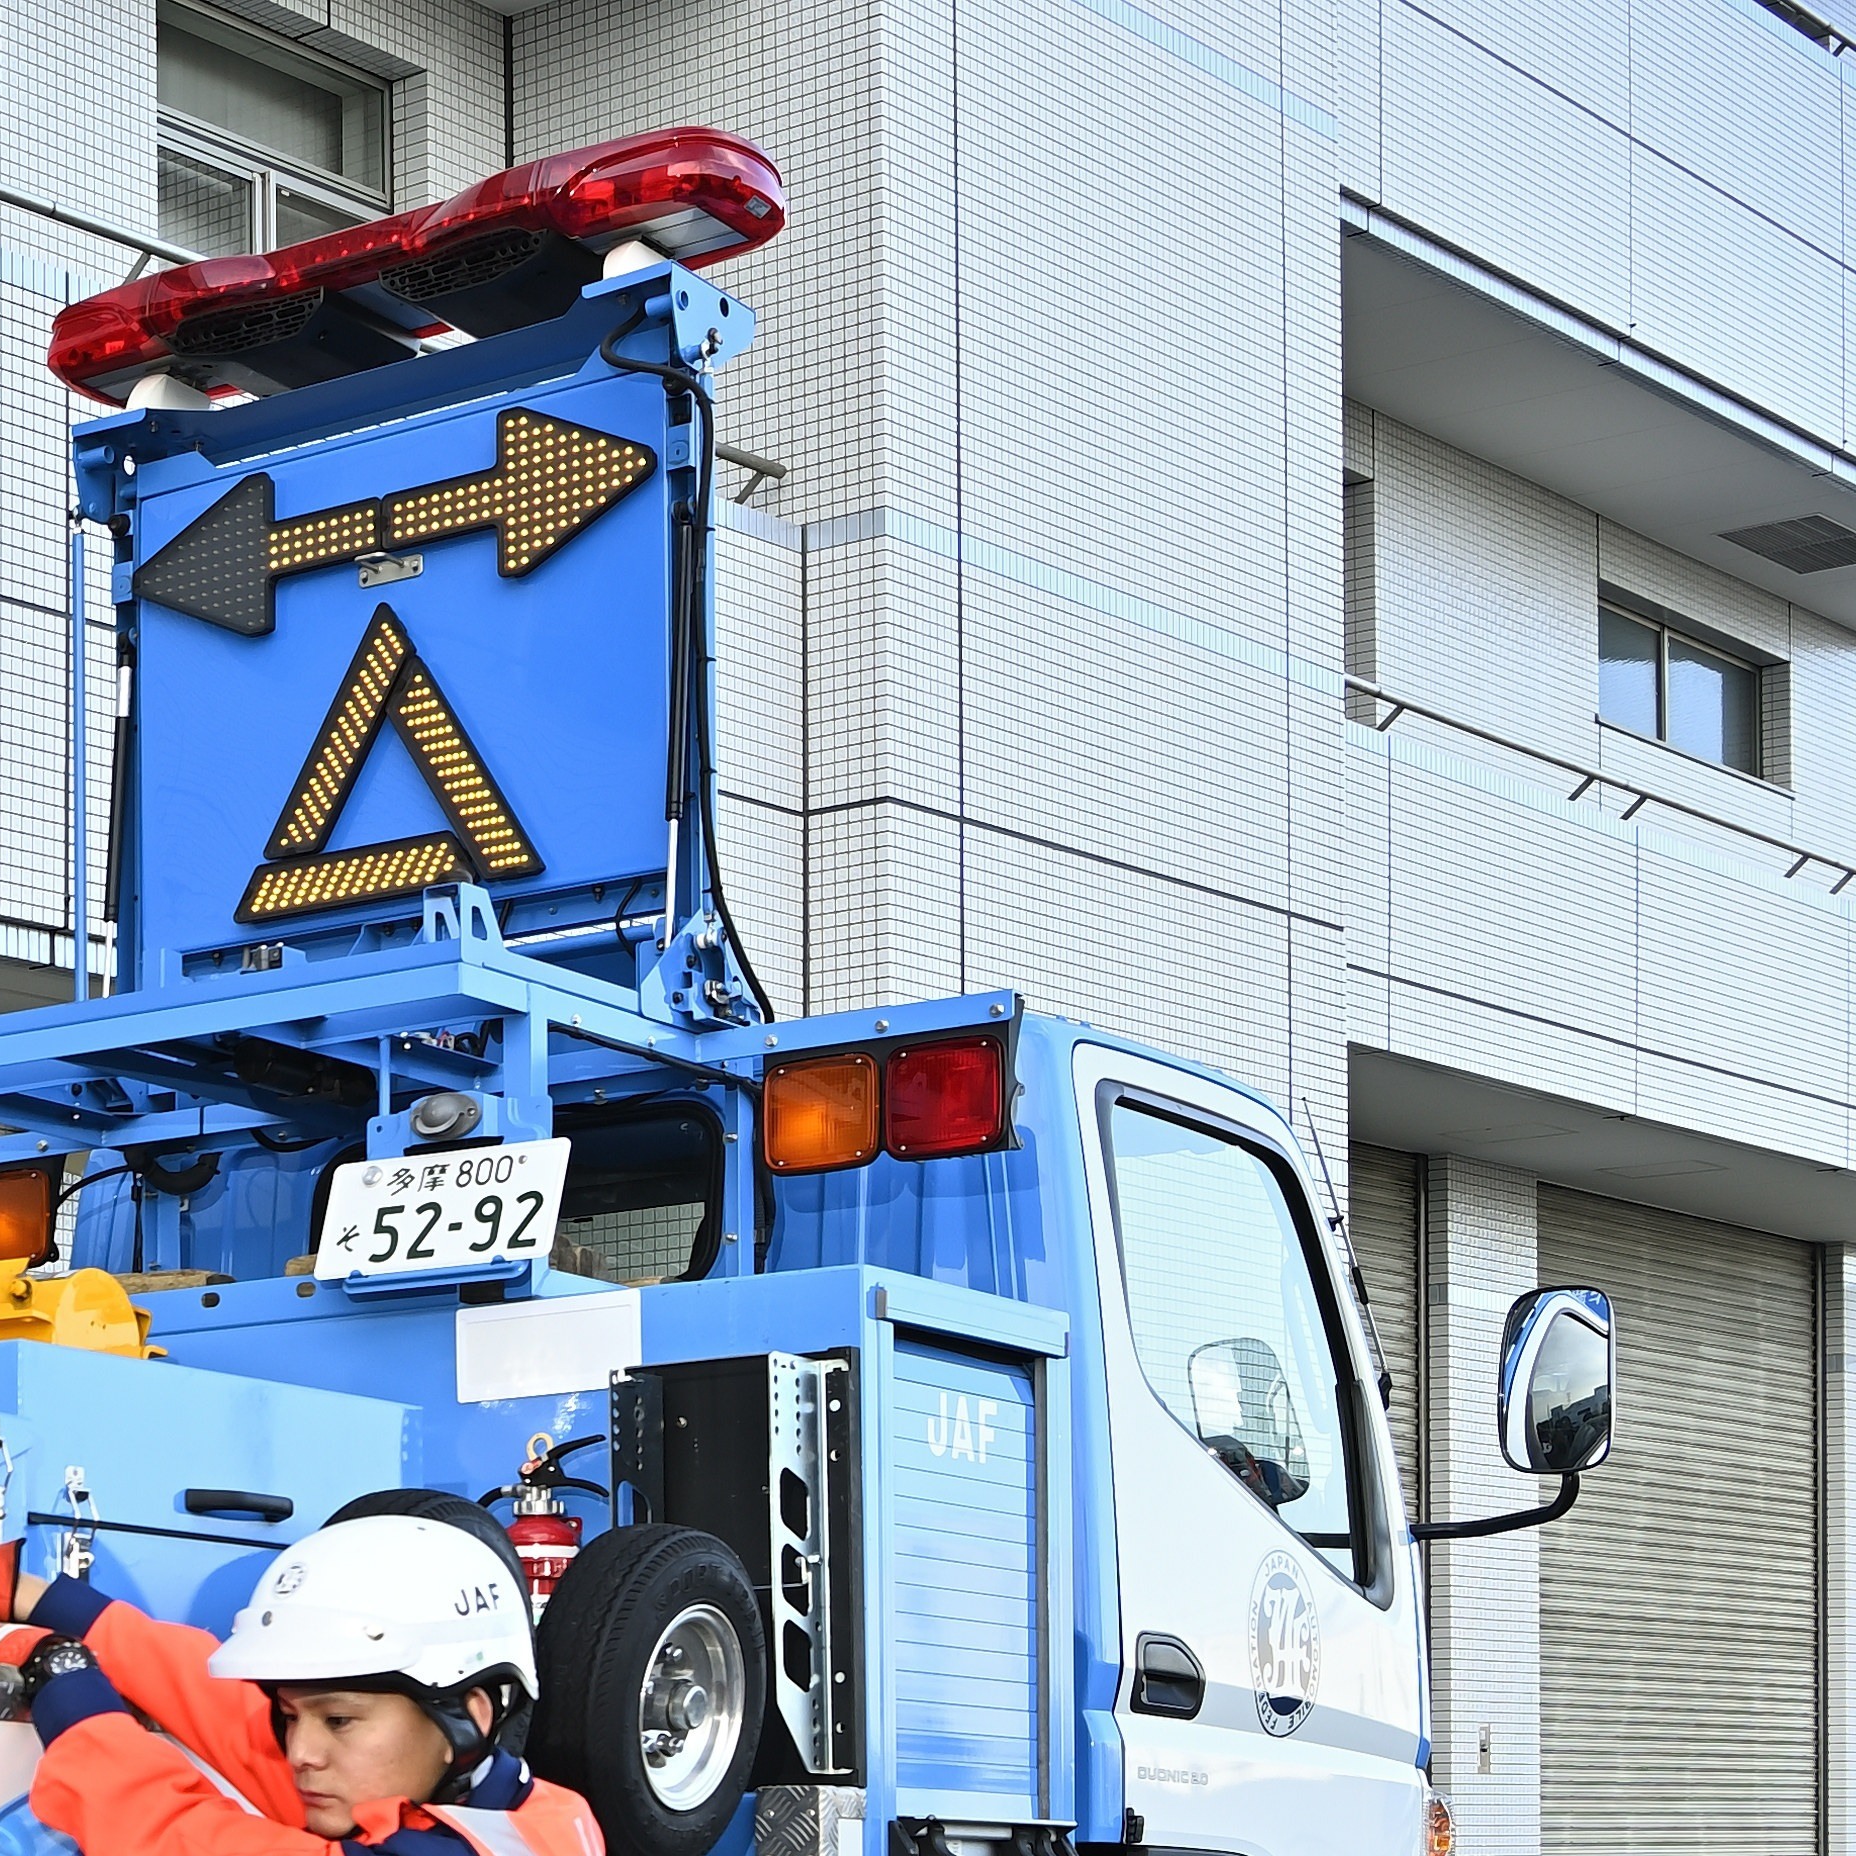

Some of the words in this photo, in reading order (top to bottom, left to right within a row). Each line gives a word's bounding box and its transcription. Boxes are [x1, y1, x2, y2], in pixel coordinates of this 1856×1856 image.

[386, 1164, 449, 1196] 多摩
[455, 1155, 513, 1189] 800
[336, 1224, 358, 1253] そ
[368, 1190, 544, 1264] 52-92
[926, 1390, 998, 1464] JAF
[1264, 1555, 1299, 1580] JAPAN
[454, 1582, 501, 1617] JAF
